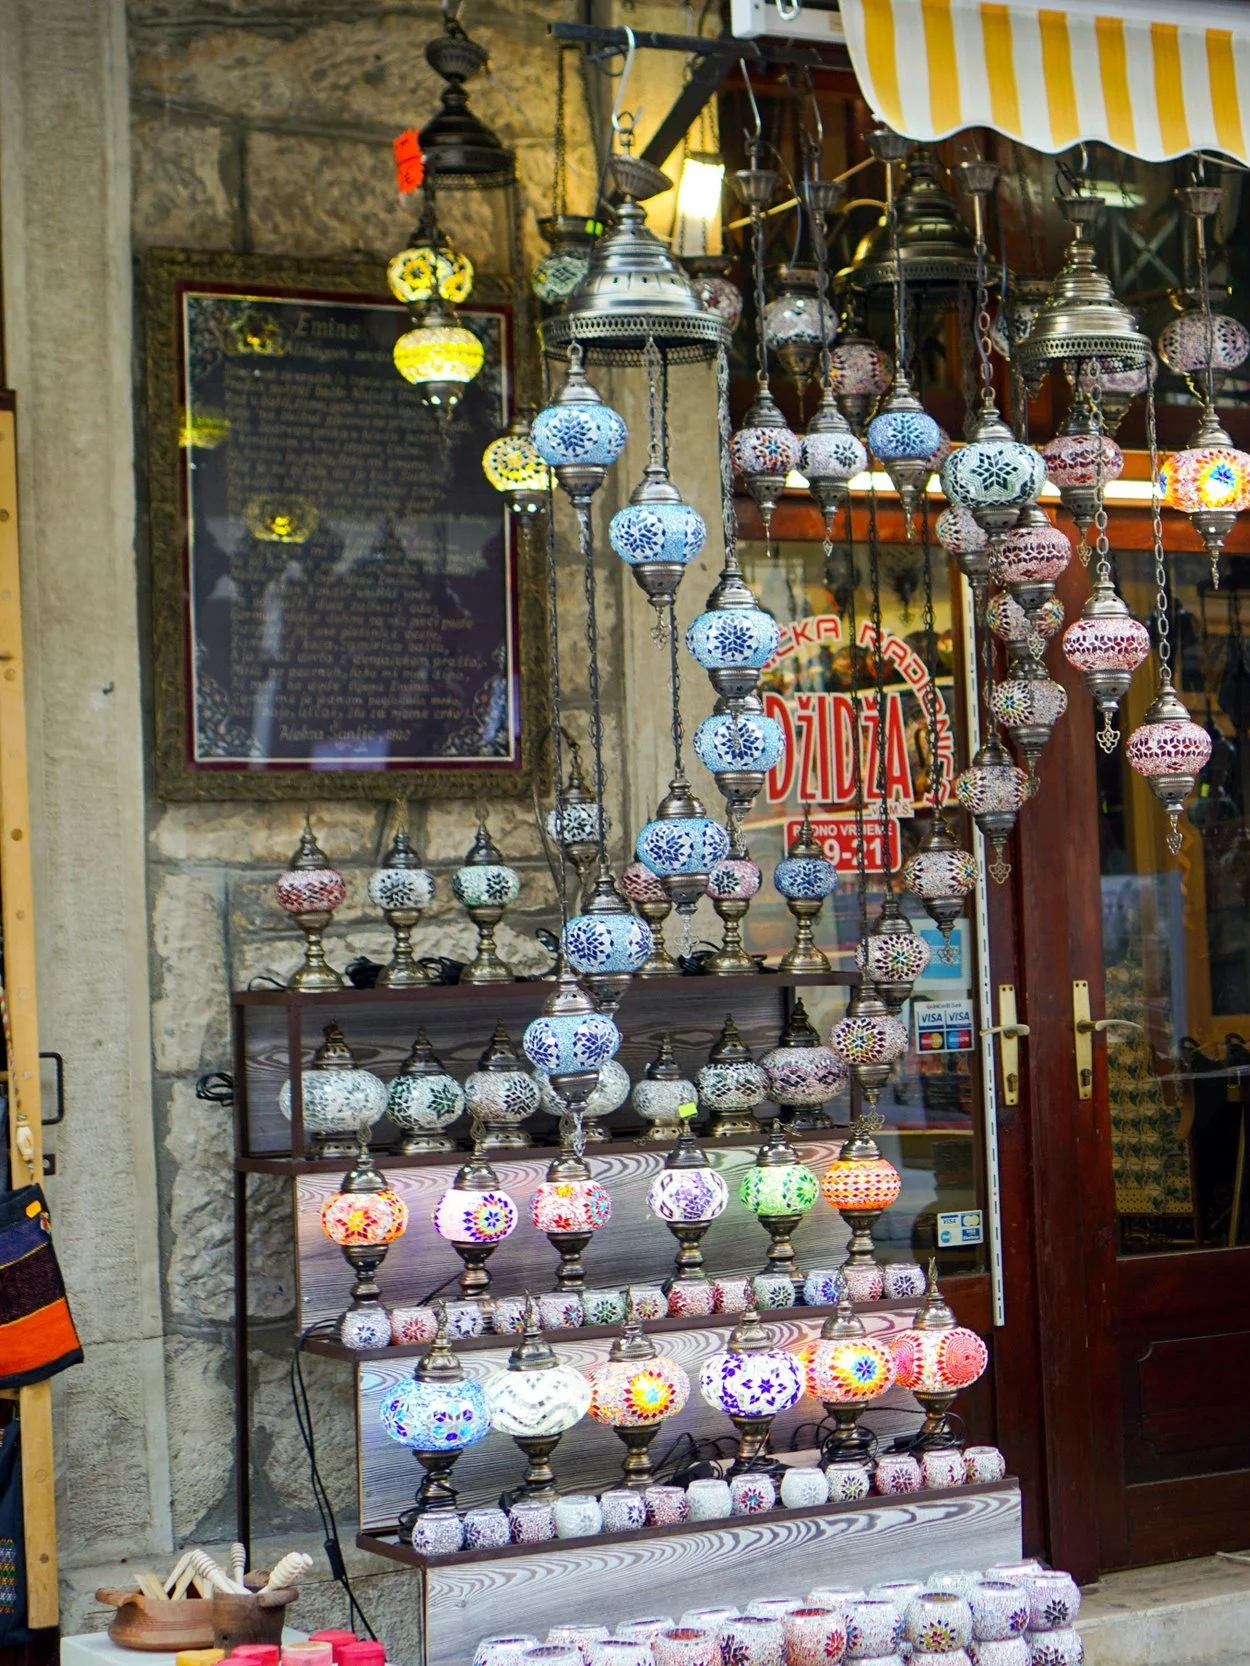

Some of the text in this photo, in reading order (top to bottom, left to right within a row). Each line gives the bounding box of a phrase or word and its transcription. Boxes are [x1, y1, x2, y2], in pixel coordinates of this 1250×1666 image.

[764, 693, 913, 802] DŽIDŽA
[793, 823, 893, 836] RDNO VRJEME
[812, 838, 884, 867] 9-21
[921, 1013, 943, 1023] VISA
[949, 1011, 970, 1021] VISA
